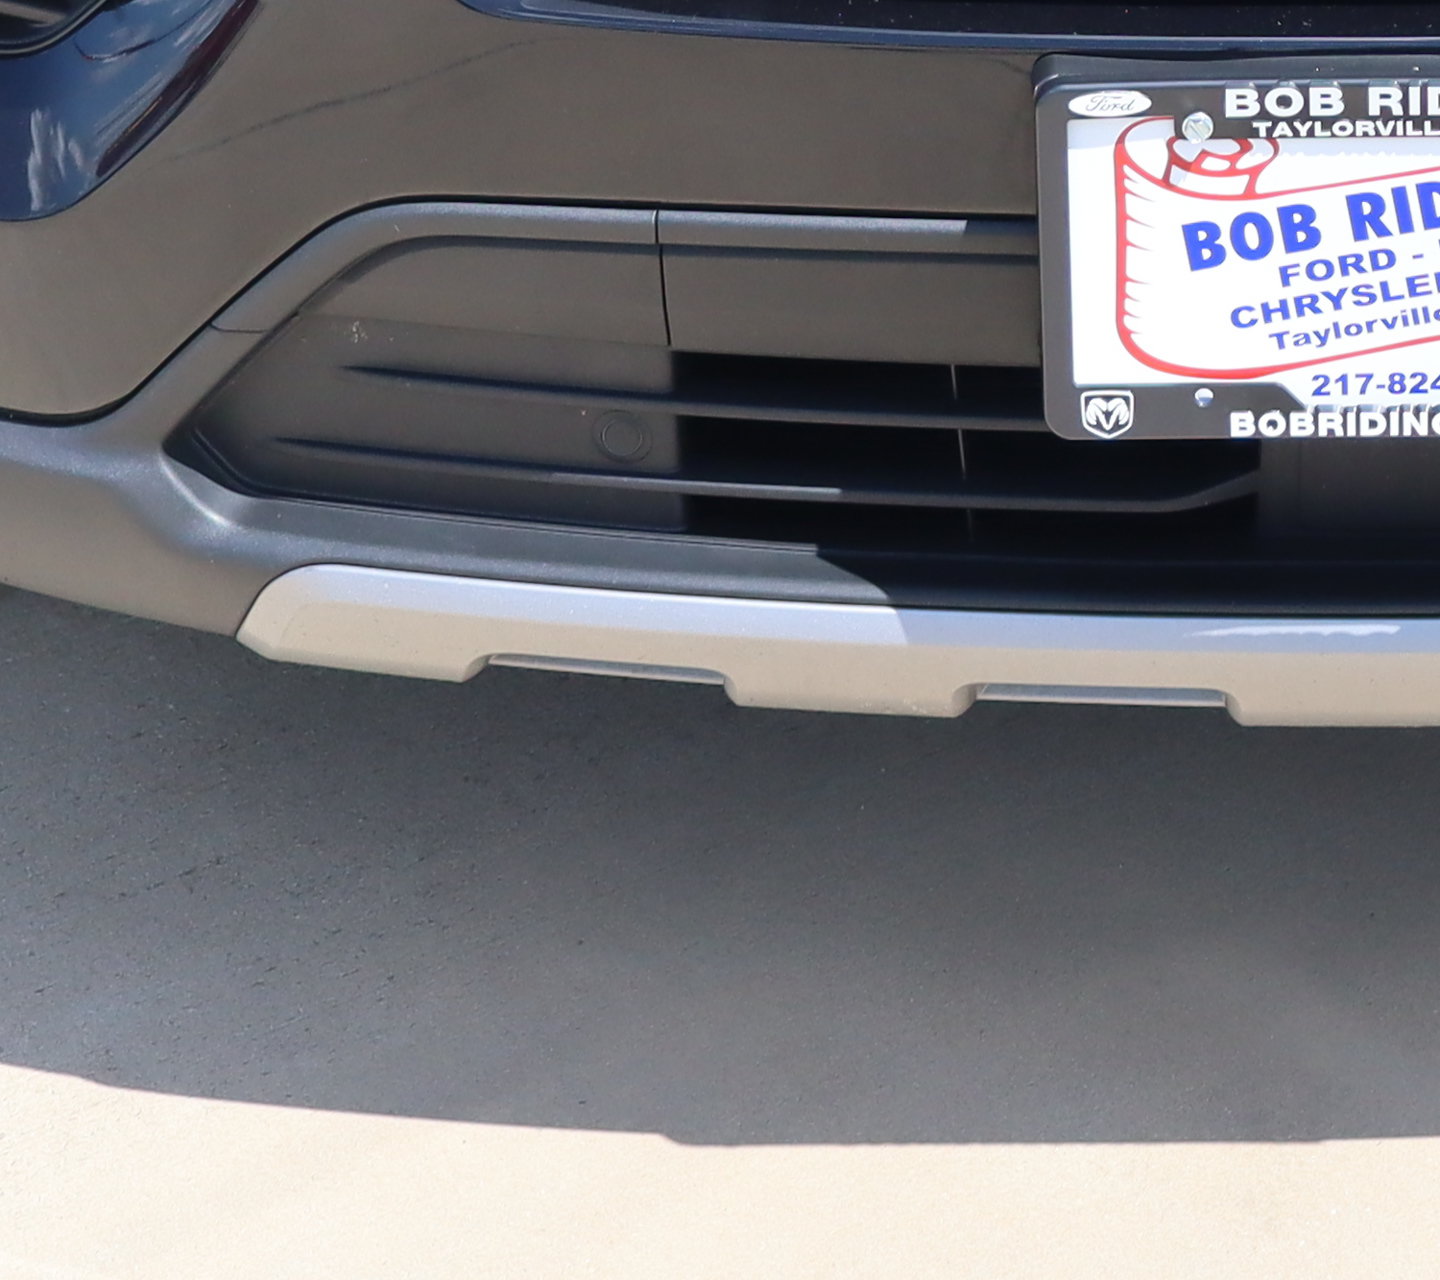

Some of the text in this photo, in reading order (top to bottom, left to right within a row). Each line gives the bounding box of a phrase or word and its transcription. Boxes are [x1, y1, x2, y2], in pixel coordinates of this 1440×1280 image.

[1224, 85, 1345, 119] BOB
[1181, 203, 1322, 272] BOB
[1278, 247, 1398, 288] FORD
